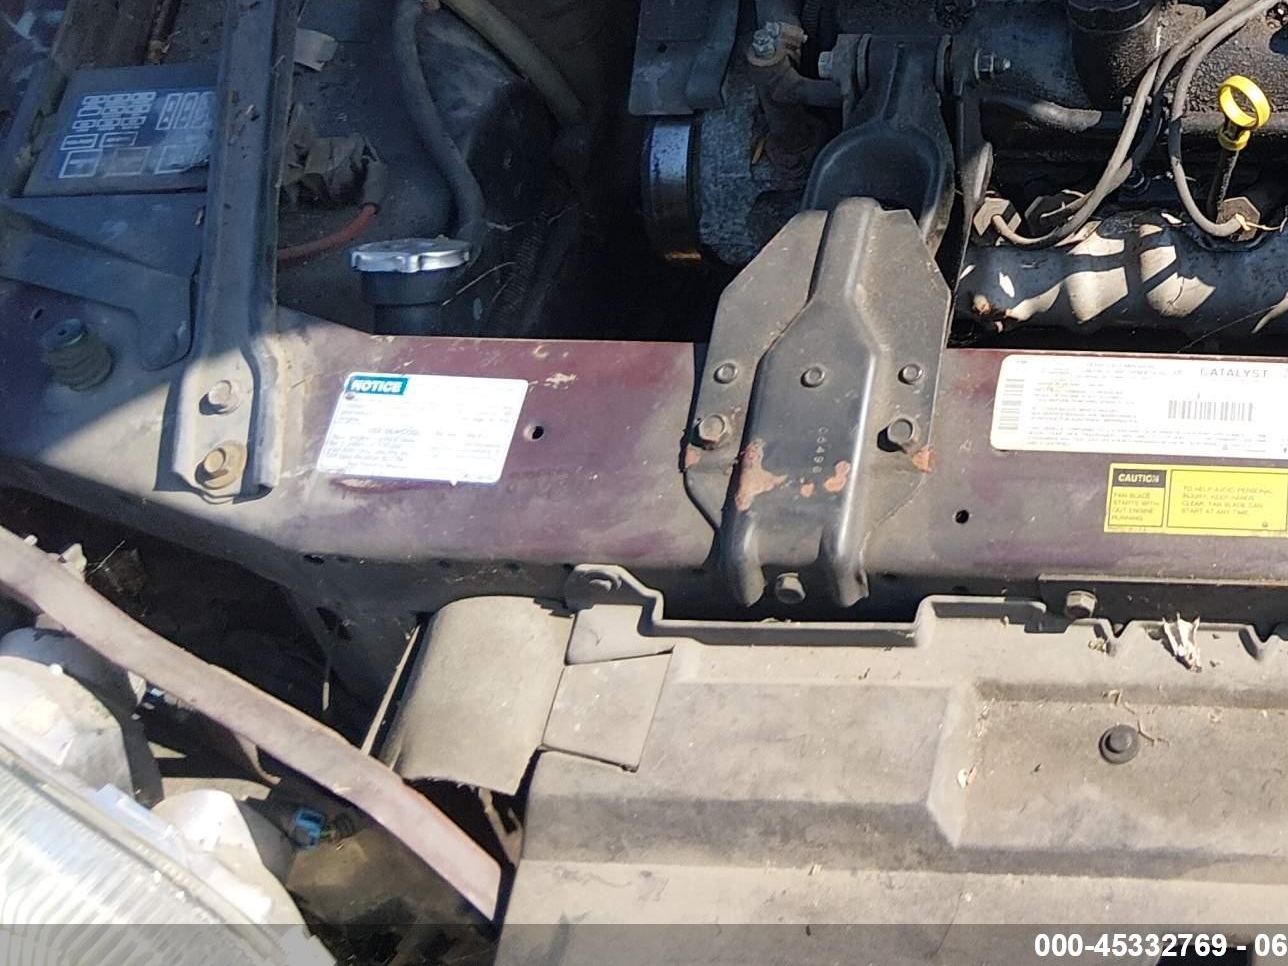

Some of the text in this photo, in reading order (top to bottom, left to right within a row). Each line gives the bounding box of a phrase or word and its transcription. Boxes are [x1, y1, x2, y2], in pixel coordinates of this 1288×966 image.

[1199, 366, 1269, 380] CATALYST
[350, 379, 402, 394] NOTICE
[1117, 471, 1160, 483] CAUTION
